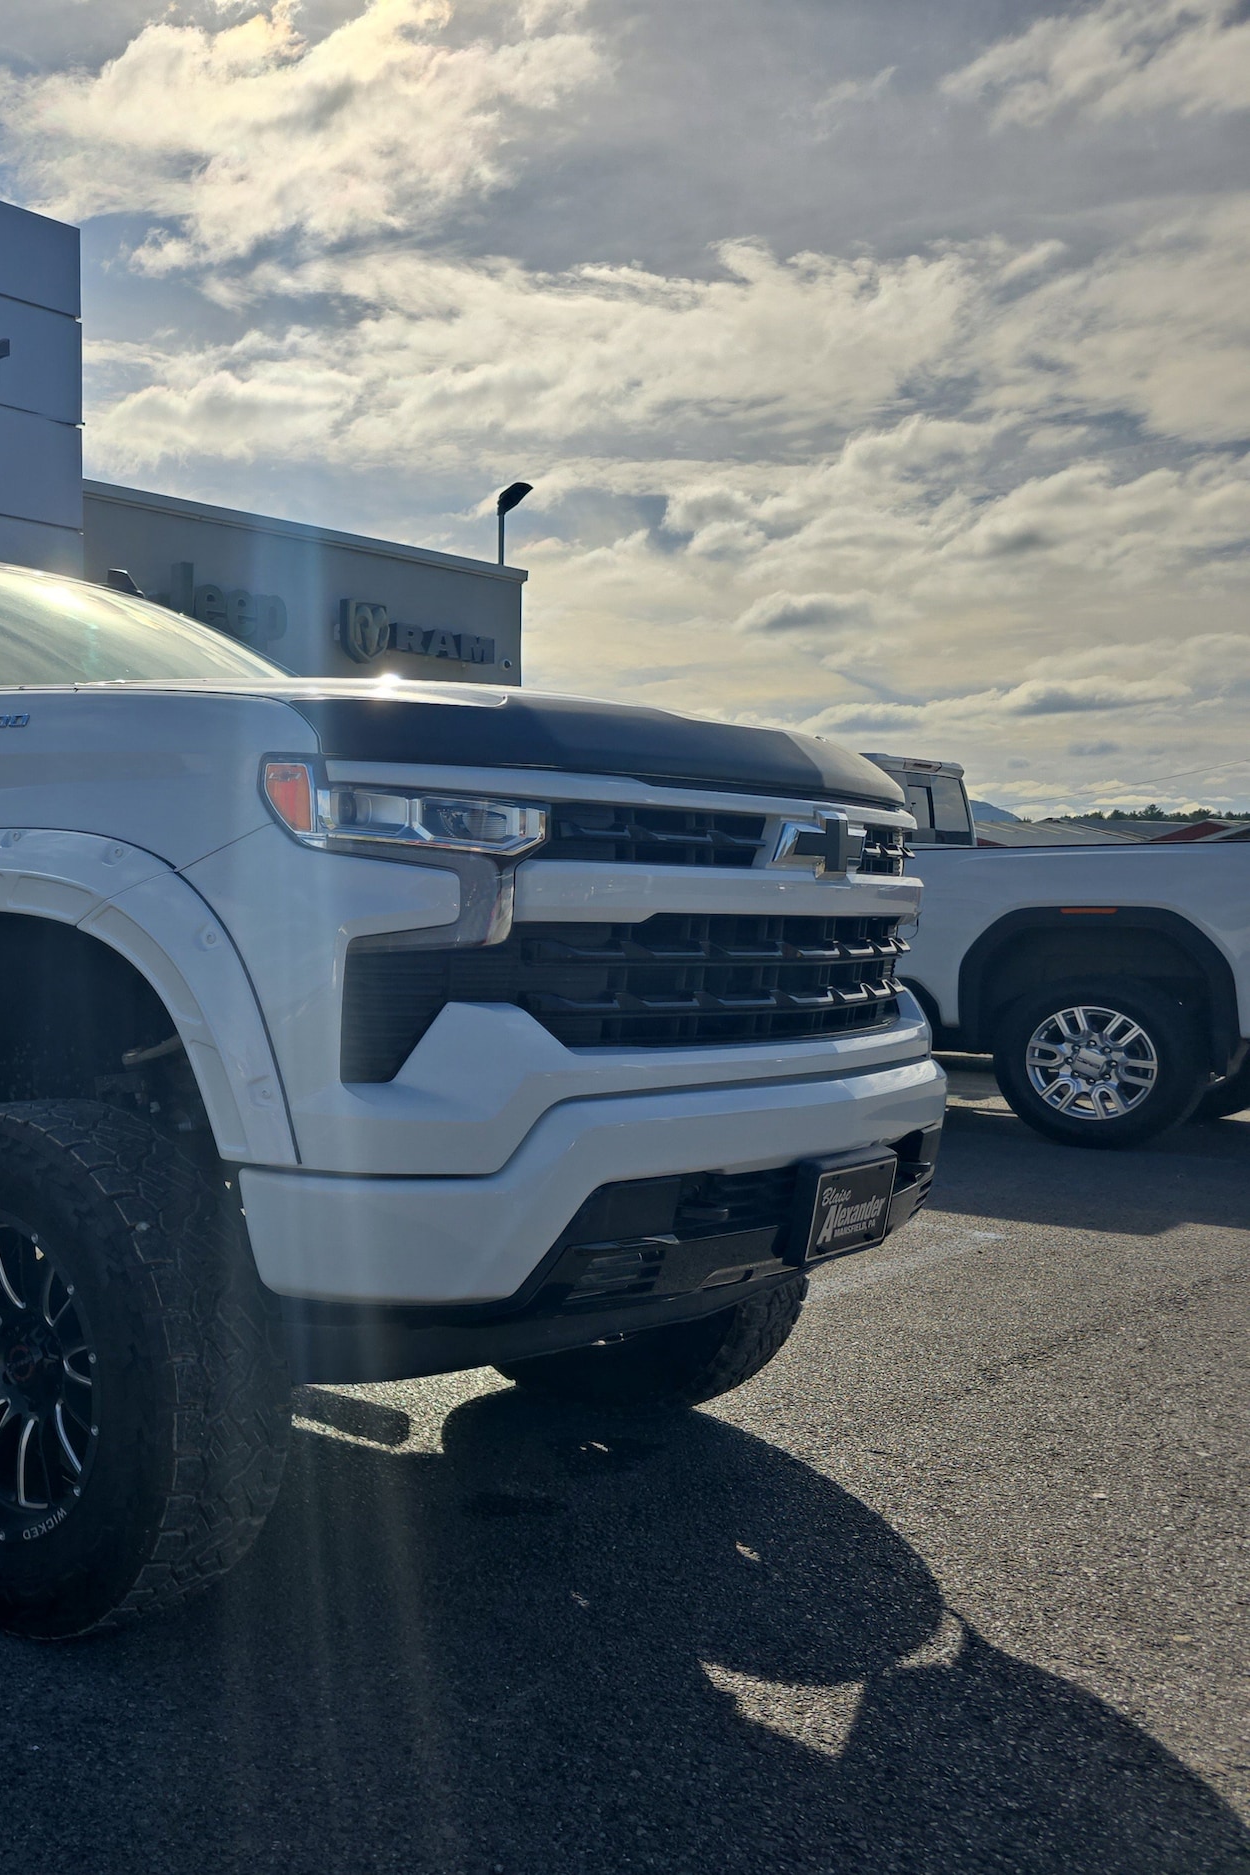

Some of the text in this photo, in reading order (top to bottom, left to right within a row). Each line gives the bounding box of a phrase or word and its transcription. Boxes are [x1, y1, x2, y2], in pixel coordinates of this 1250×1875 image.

[388, 622, 496, 665] RAM
[821, 1187, 852, 1207] Blaise
[816, 1195, 886, 1245] Alexander
[867, 1219, 876, 1228] PA
[22, 1507, 67, 1541] WICKED
